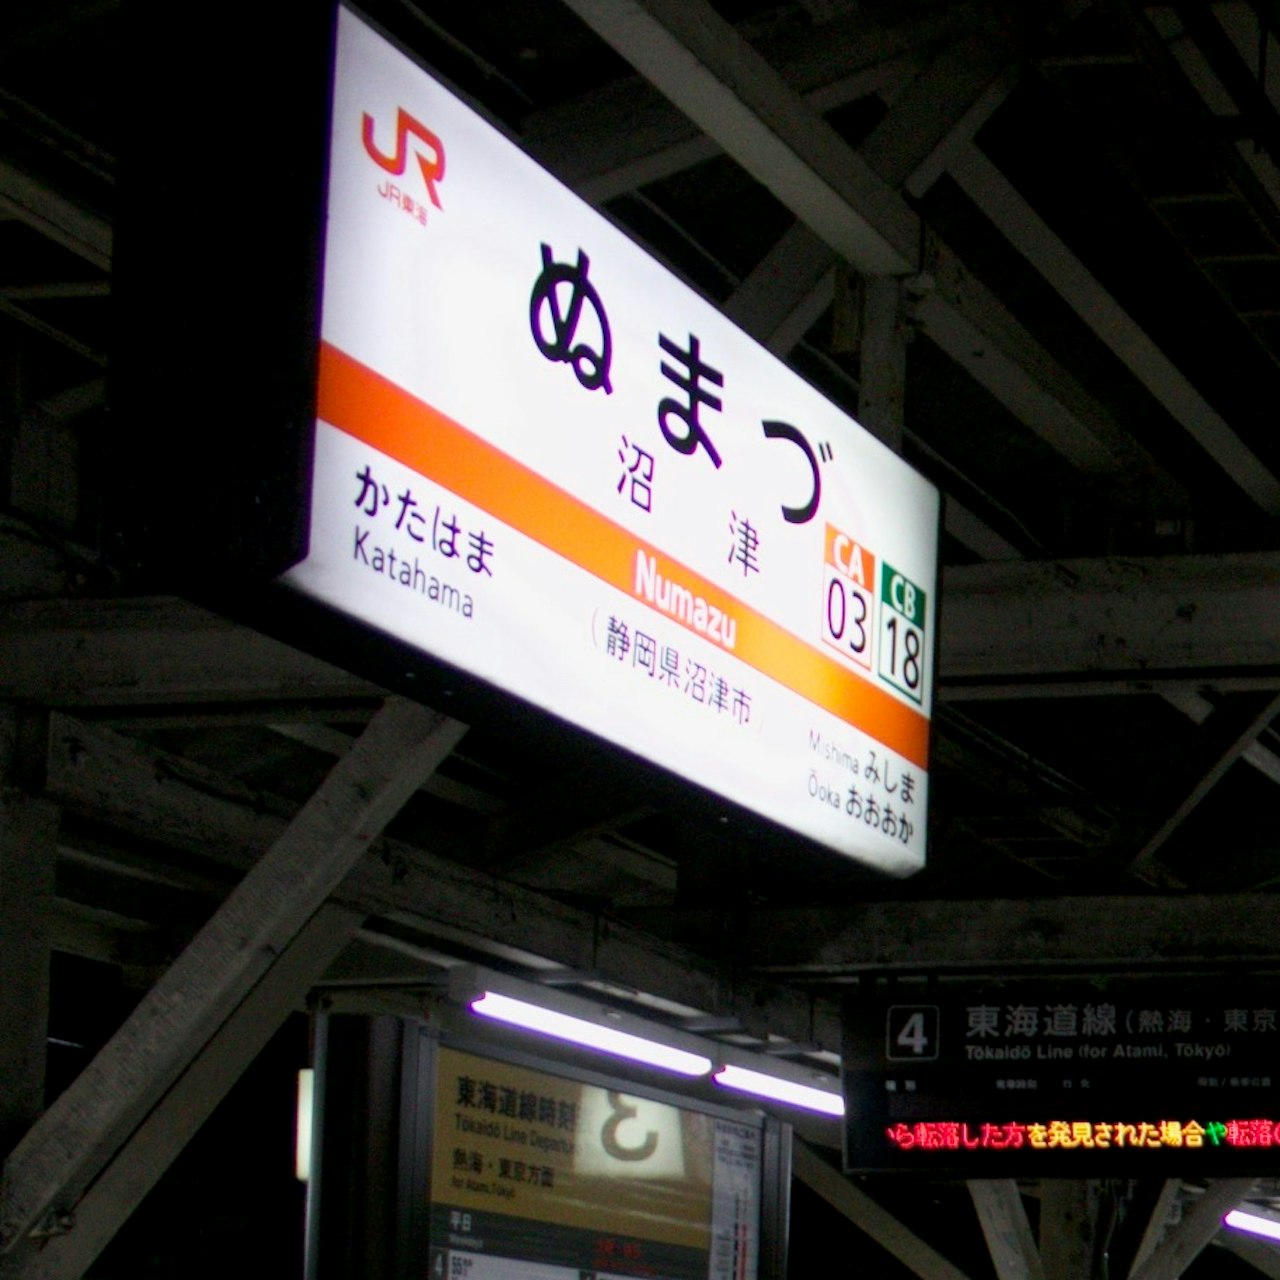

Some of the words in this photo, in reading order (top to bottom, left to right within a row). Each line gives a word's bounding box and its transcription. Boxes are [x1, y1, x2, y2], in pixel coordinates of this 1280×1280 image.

[362, 106, 446, 212] JR
[377, 181, 430, 226] JR東海
[530, 242, 835, 525] ぬまづ
[355, 464, 496, 581] かたはま
[831, 532, 867, 590] CA
[353, 528, 475, 620] Katahama
[633, 549, 738, 650] Numazu
[887, 570, 919, 620] CB
[827, 577, 870, 658] 03
[883, 614, 923, 694] 18
[808, 729, 861, 778] Mishima
[863, 748, 916, 806] みしま
[845, 783, 914, 846] おおおか
[896, 1010, 929, 1056] 4
[1036, 1041, 1074, 1061] Line
[435, 1254, 443, 1275] 4
